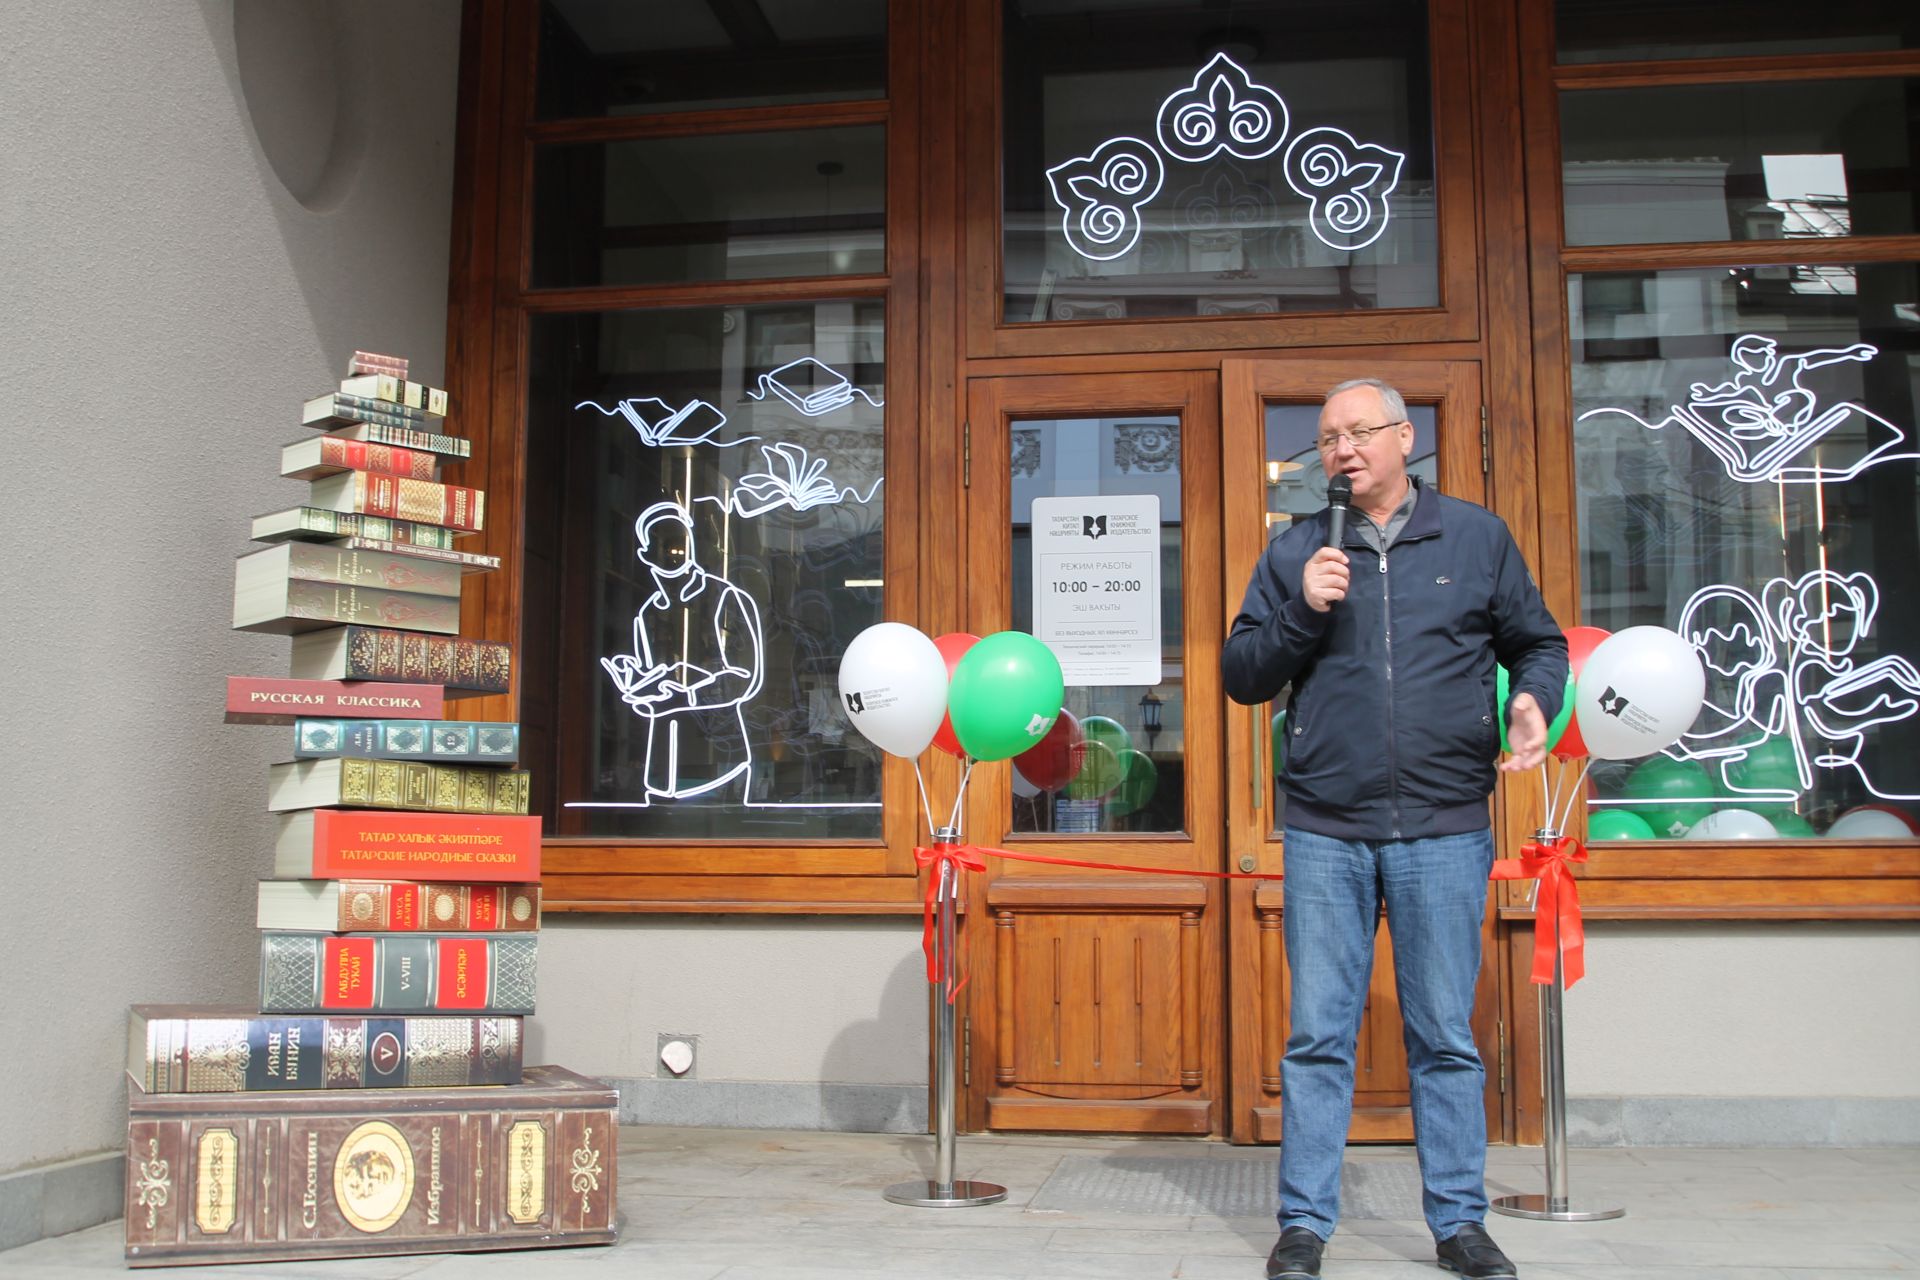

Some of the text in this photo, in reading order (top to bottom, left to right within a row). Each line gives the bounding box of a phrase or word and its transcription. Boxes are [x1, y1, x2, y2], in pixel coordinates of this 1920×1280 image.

[1060, 561, 1132, 571] РЕЖИМ РАБОТЫ
[1052, 580, 1088, 593] 10:00
[1104, 580, 1141, 592] 20:00
[1072, 603, 1120, 612] ЭШ ВАКЫТЫ
[250, 692, 422, 708] РУССКАЯ КЛАССИКА
[447, 735, 456, 746] 12
[358, 831, 503, 846] ТАТАР ХАЛЫК ӘКИЯТЛӘРЕ
[340, 850, 516, 864] ТАТАРСКИЕ НАРОДНЫЕ СКАЗКИ
[339, 947, 349, 999] ГАБДУЛЛА
[350, 956, 361, 989] ТУКАЙ
[401, 956, 411, 991] V-VIII
[456, 948, 467, 998] ӘСӘРЛӘР
[266, 1032, 281, 1076] ИВАН
[286, 1027, 300, 1081] БУНИН
[380, 1047, 395, 1061] V
[303, 1132, 318, 1230] С.Есенин
[427, 1126, 441, 1226] Избранное
